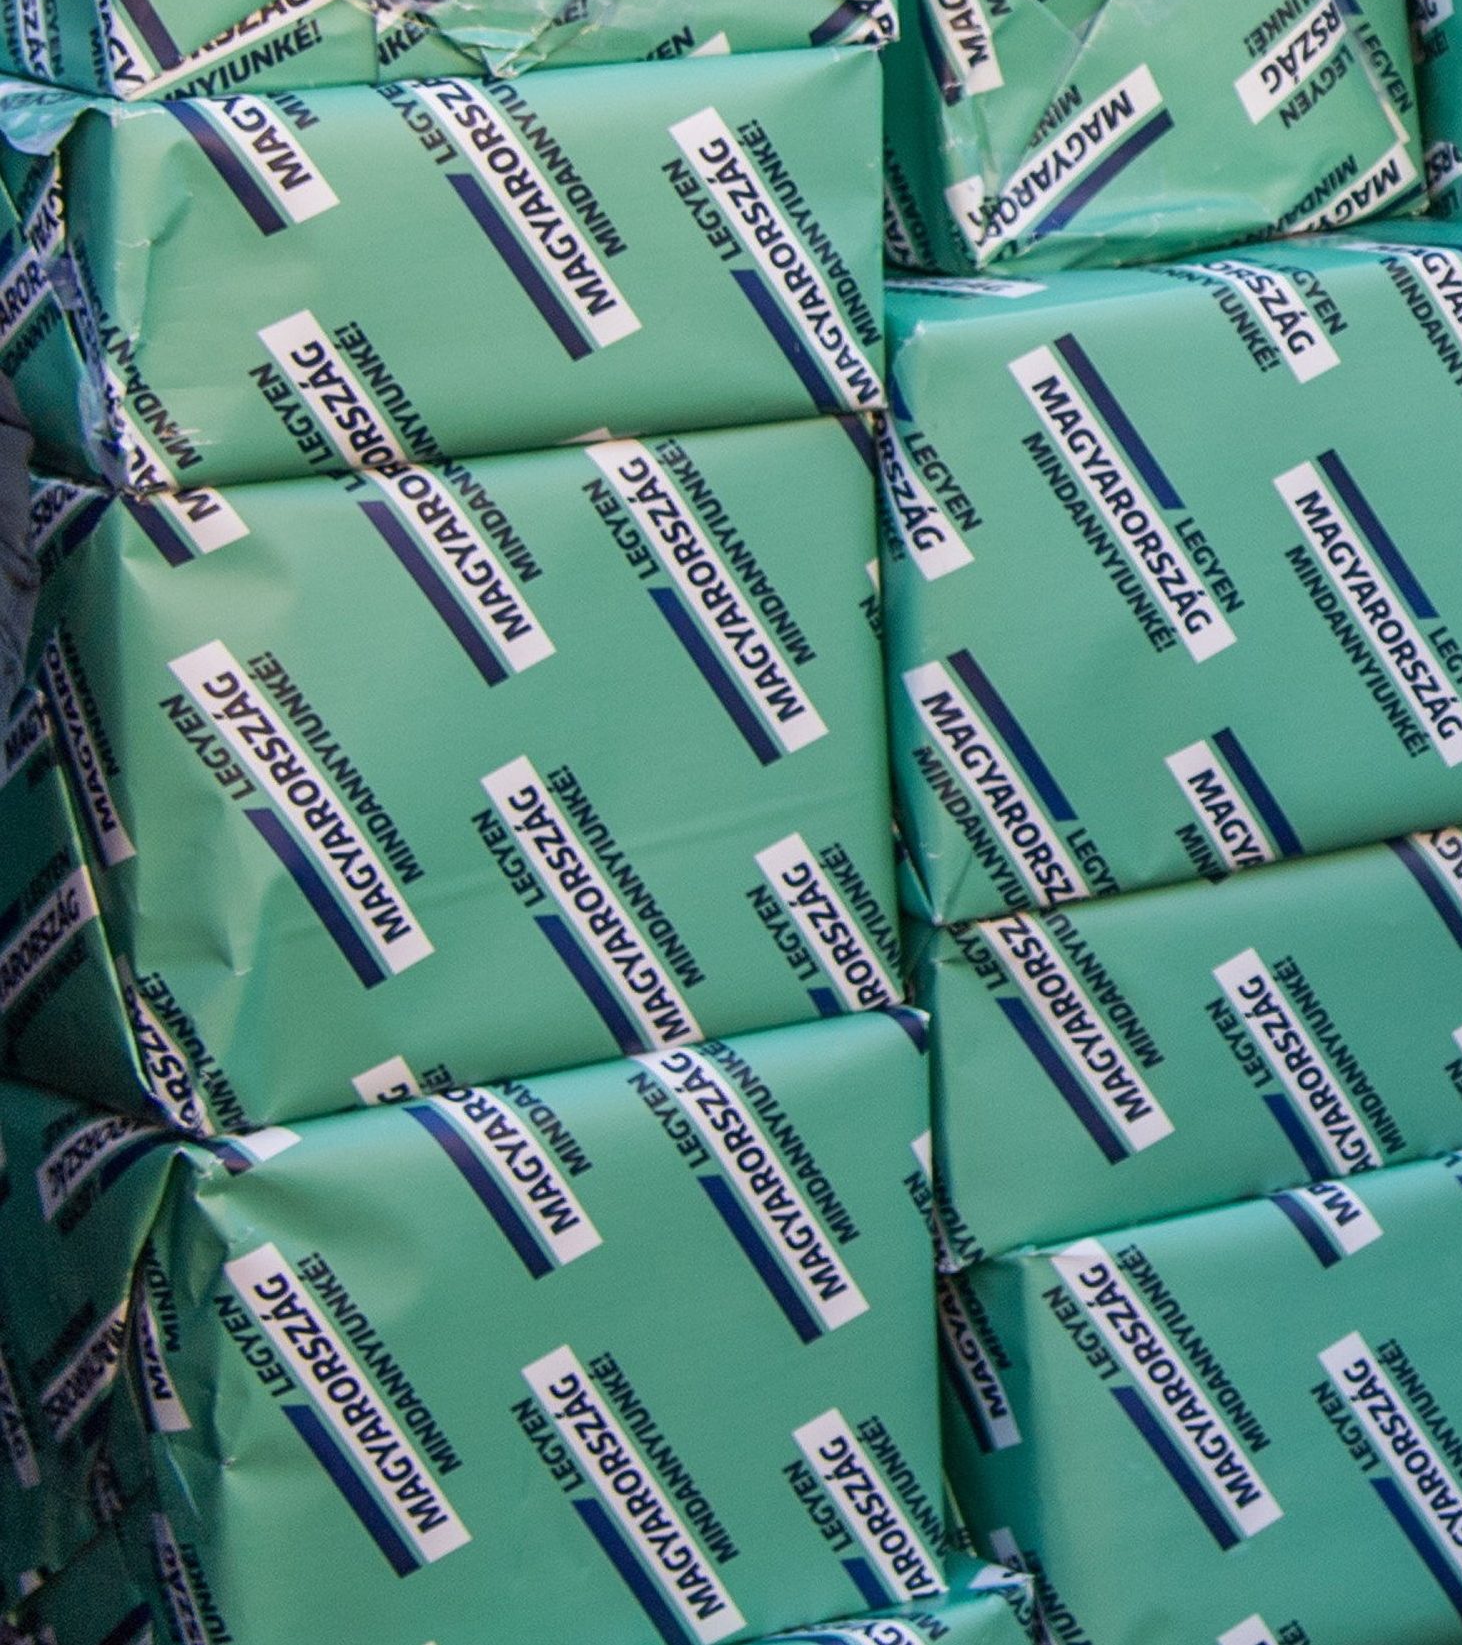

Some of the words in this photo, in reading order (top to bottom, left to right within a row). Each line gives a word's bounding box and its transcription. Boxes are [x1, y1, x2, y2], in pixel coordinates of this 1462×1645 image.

[1279, 45, 1352, 129] LEGYEN
[1358, 23, 1412, 113] LEGYEN
[661, 157, 742, 262] LEGYEN
[698, 137, 881, 410] MAGYARORSZÁG
[737, 118, 884, 347] MINDANNYIUNKÉ!
[249, 363, 331, 465] LEGYEN
[904, 431, 981, 532] LEGYEN
[1032, 376, 1213, 635] MAGYARORSZÁG
[581, 476, 660, 579] LEGYEN
[618, 455, 806, 724] MAGYARORSZÁG
[655, 439, 817, 667] MINDANNYIUNKÉ!
[1023, 433, 1177, 654] MINDANNYIUNKÉ!
[1176, 517, 1246, 613] LEGYEN
[1295, 490, 1462, 740] MAGYARORSZÁG
[159, 694, 257, 802] LEGYEN
[1284, 546, 1430, 757] MINDANNYIUNKÉ!
[202, 669, 413, 944] MAGYARORSZÁG
[247, 650, 424, 885] MINDANNYIUNKÉ!
[470, 807, 548, 908] LEGYEN
[508, 784, 691, 1043] MAGYARORSZÁG
[546, 765, 705, 988] MINDANNYIUNKÉ!
[745, 883, 821, 981] LEGYEN
[627, 1071, 710, 1171] LEGYEN
[701, 1042, 860, 1243] MINDANNYIUNKÉ
[1206, 996, 1274, 1089] LEGYEN
[1273, 955, 1408, 1155] MINDANNYIUNKÉ!
[662, 1053, 846, 1301] MAGYARORSZÁG
[215, 1293, 296, 1398] LEGYEN
[254, 1273, 447, 1534] MAGYARORSZÁG
[297, 1252, 462, 1475] MINDANNYIUNKÉ!
[1042, 1286, 1119, 1381] LEGYEN
[1080, 1263, 1261, 1509] MAGYARORSZÁG
[1117, 1243, 1271, 1452] MINDANNYIUNKÉ!
[1310, 1381, 1381, 1473] LEGYEN
[511, 1397, 584, 1493] LEGYEN
[549, 1372, 726, 1621] MAGYARORSZÁG
[588, 1352, 740, 1564] MINDANNYIUNKÉ!
[782, 1458, 855, 1553] LEGYEN
